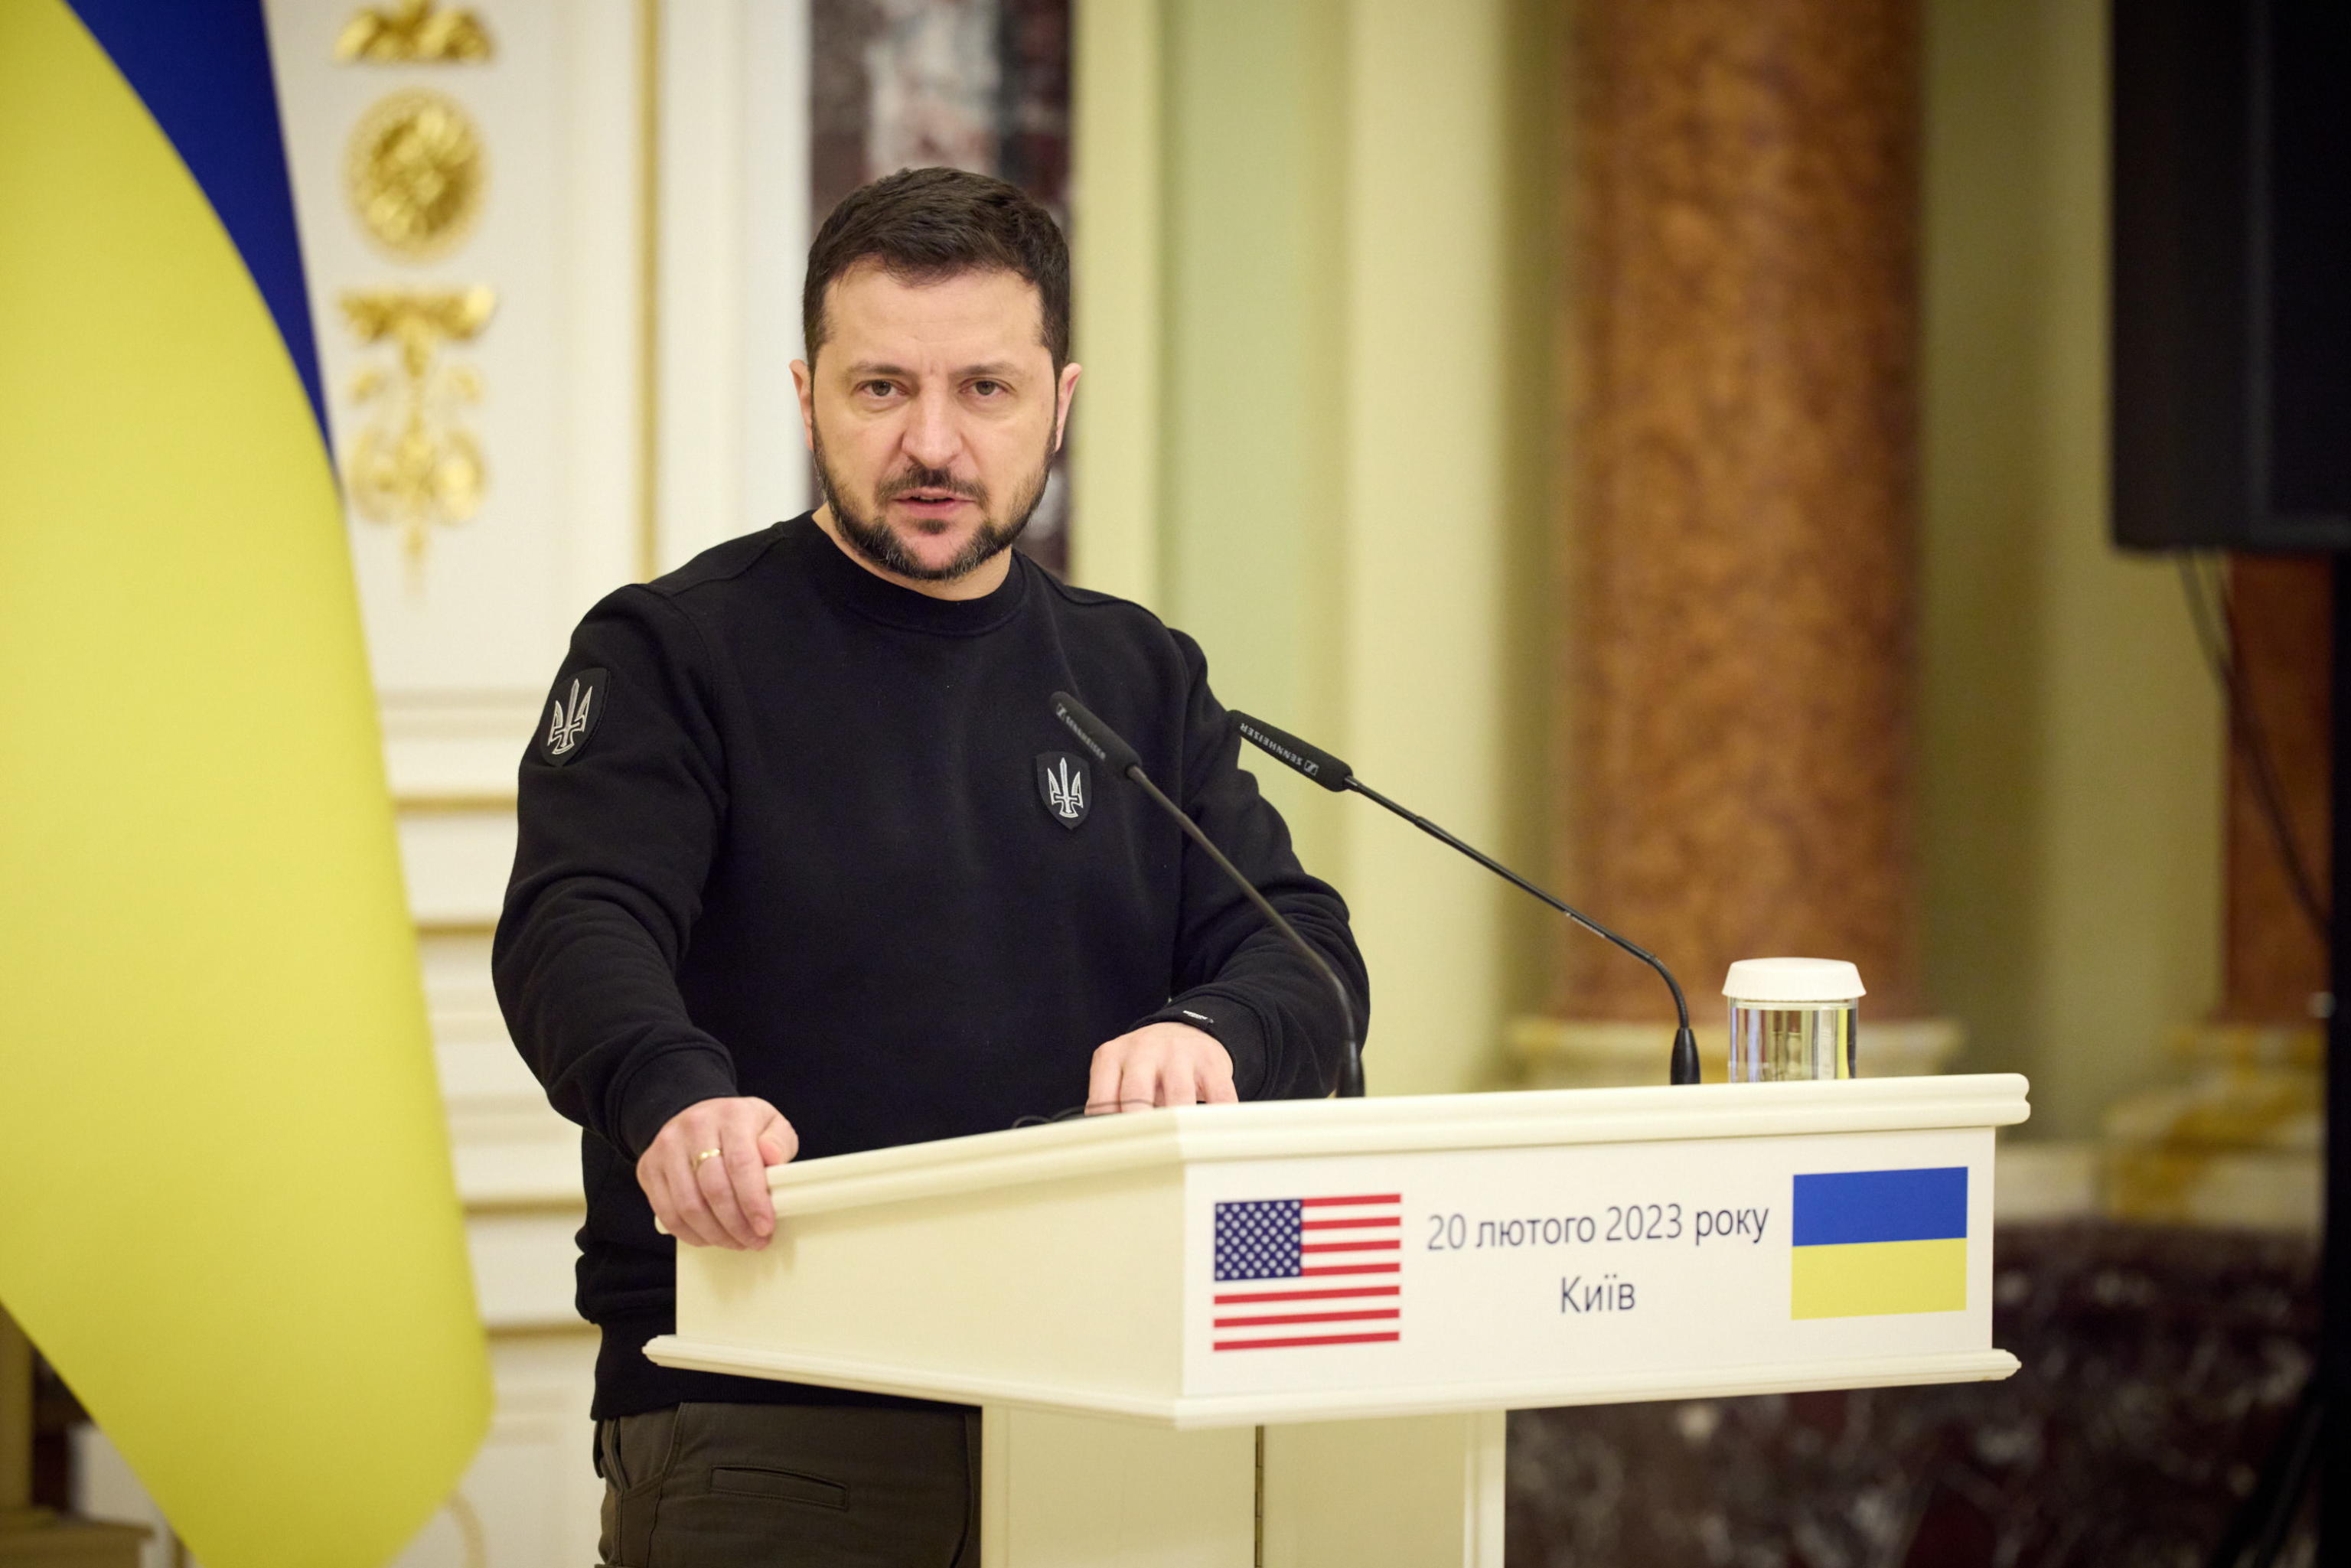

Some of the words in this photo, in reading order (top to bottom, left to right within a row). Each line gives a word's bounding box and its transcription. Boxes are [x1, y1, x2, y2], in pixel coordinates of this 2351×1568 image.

[1240, 722, 1303, 766] SENNHEISER
[1427, 1214, 1466, 1250] 20
[1475, 1216, 1596, 1248] лютого
[1606, 1202, 1682, 1242] 2023
[1695, 1208, 1769, 1247] року
[1561, 1273, 1635, 1314] Київ
